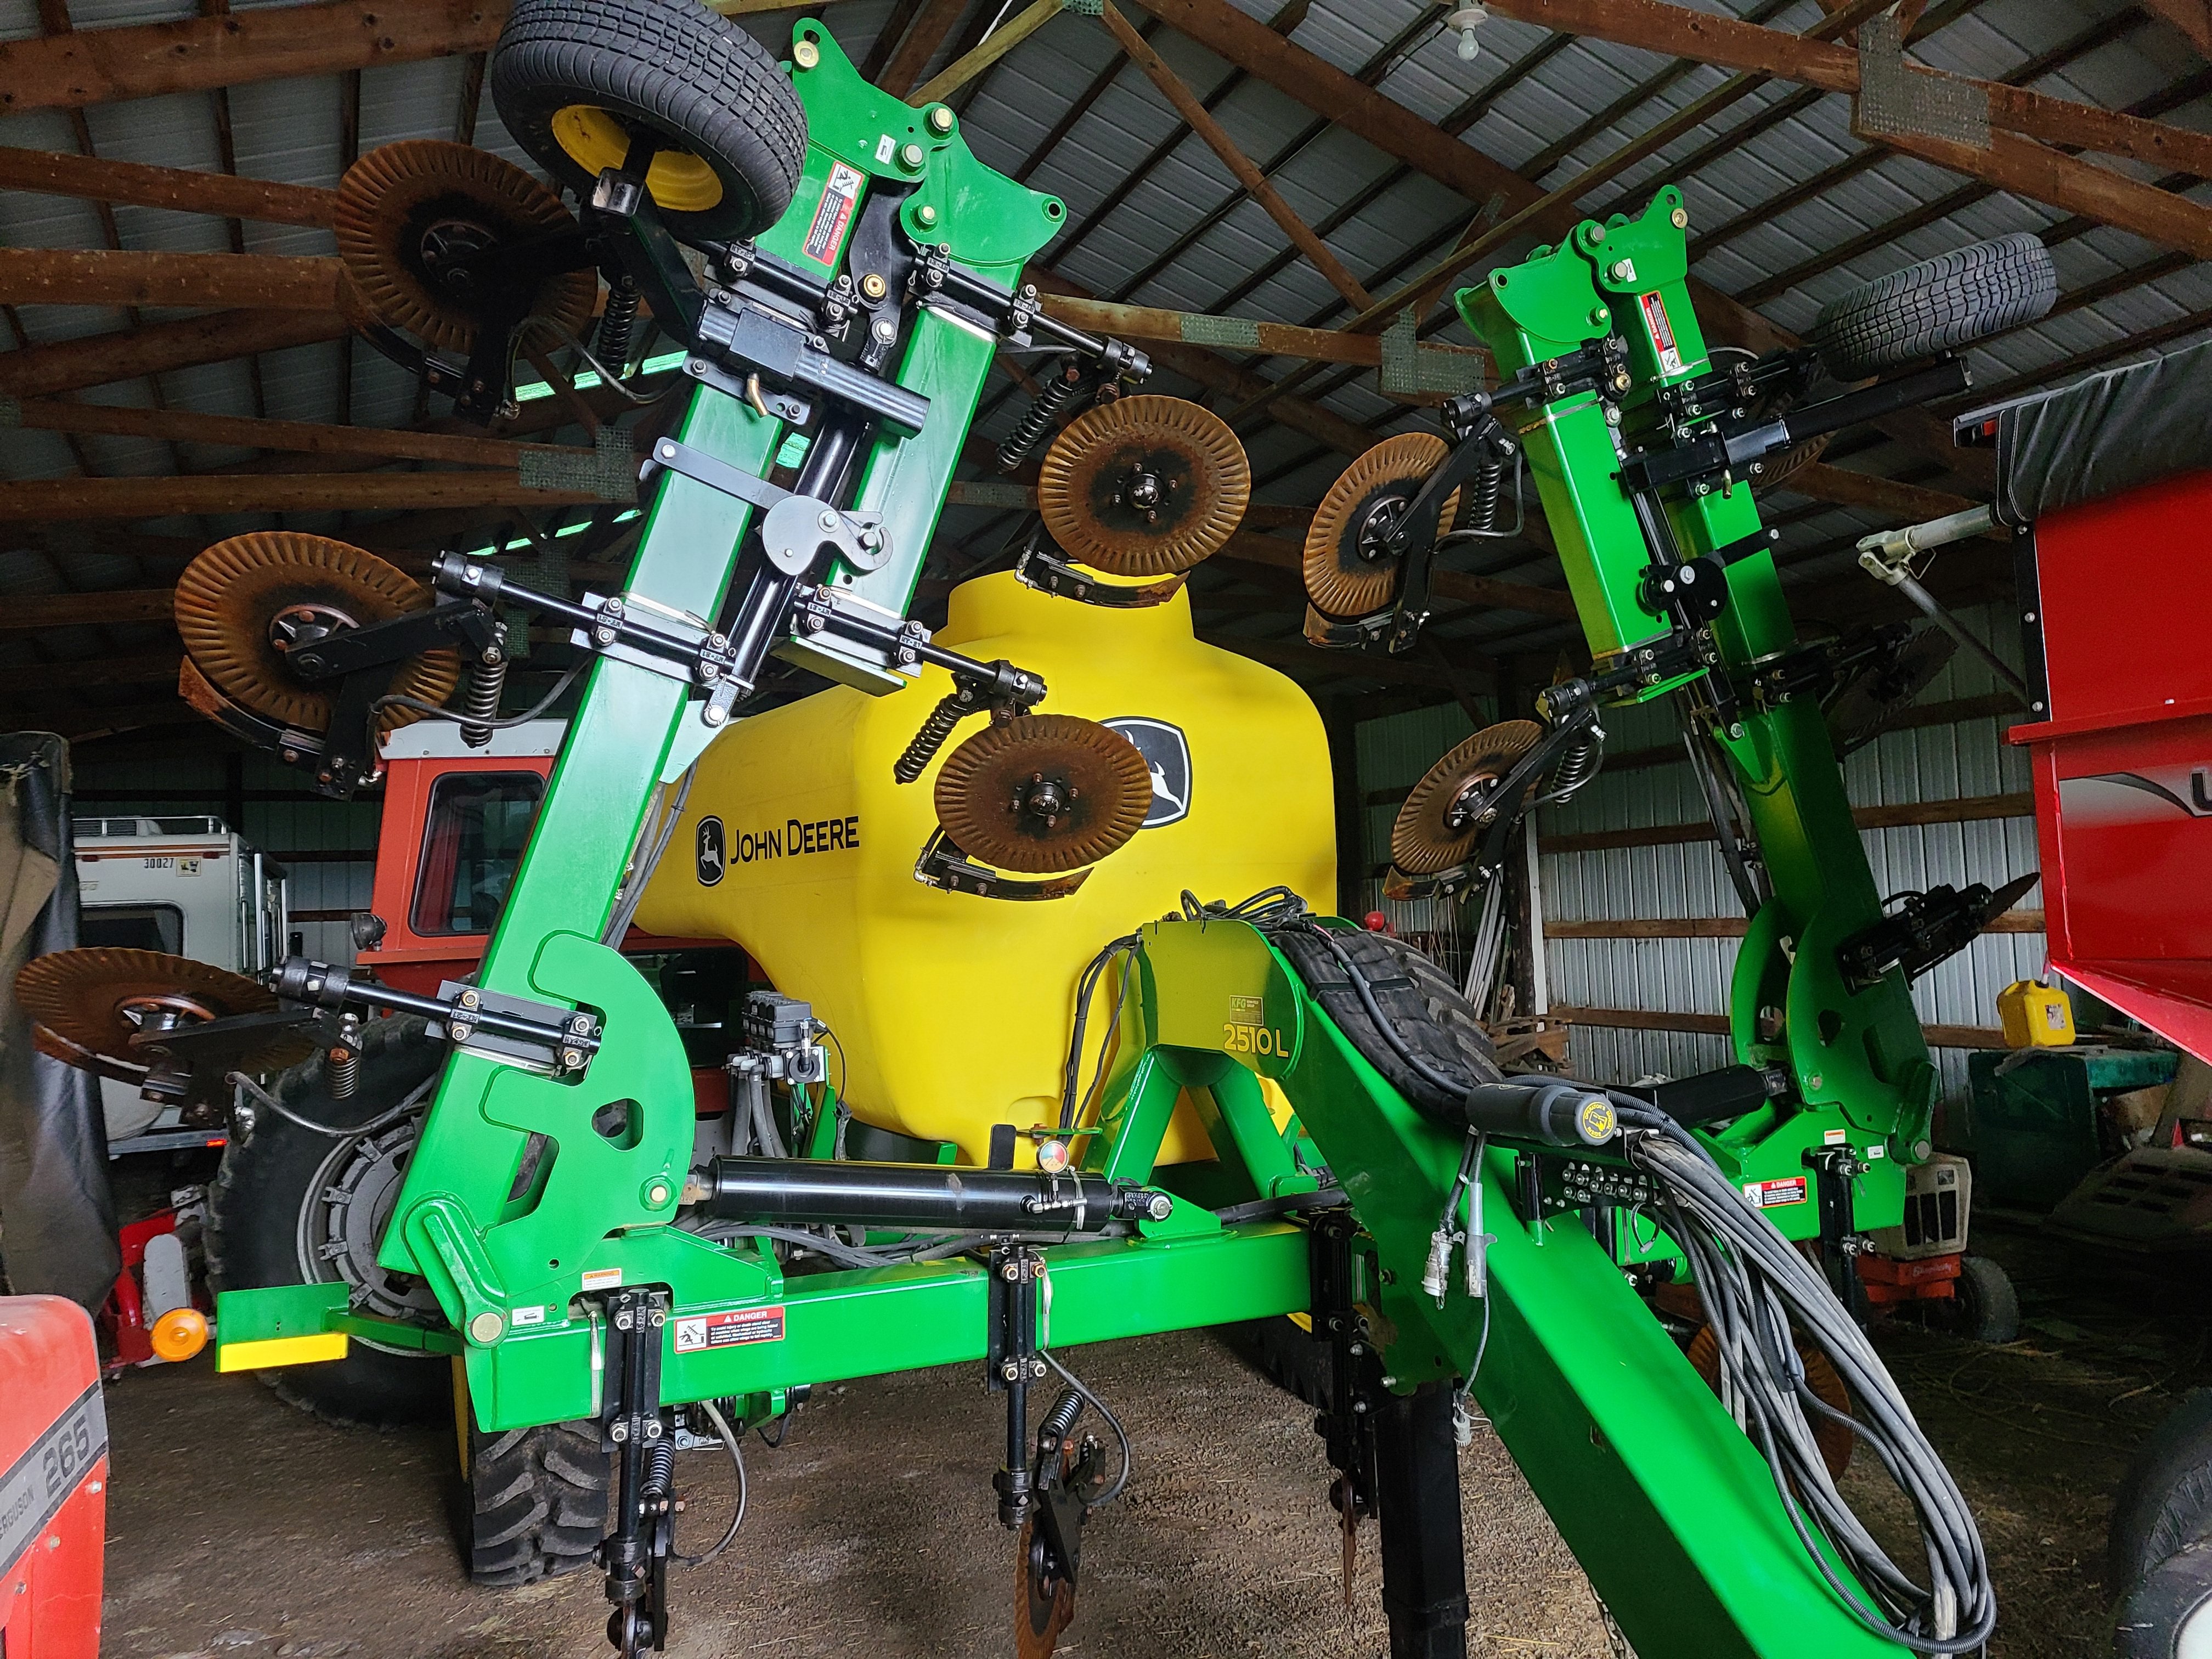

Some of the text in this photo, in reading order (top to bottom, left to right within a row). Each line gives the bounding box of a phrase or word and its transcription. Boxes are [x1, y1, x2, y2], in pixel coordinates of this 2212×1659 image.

[828, 221, 847, 251] DANGER
[730, 815, 860, 865] JOHN DEERE
[143, 857, 174, 869] 30027
[1231, 997, 1246, 1008] KFG
[1223, 1024, 1289, 1058] 2510 L
[1776, 1180, 1797, 1188] DANGER
[733, 1311, 768, 1322] DANGER
[43, 1413, 90, 1499] 265
